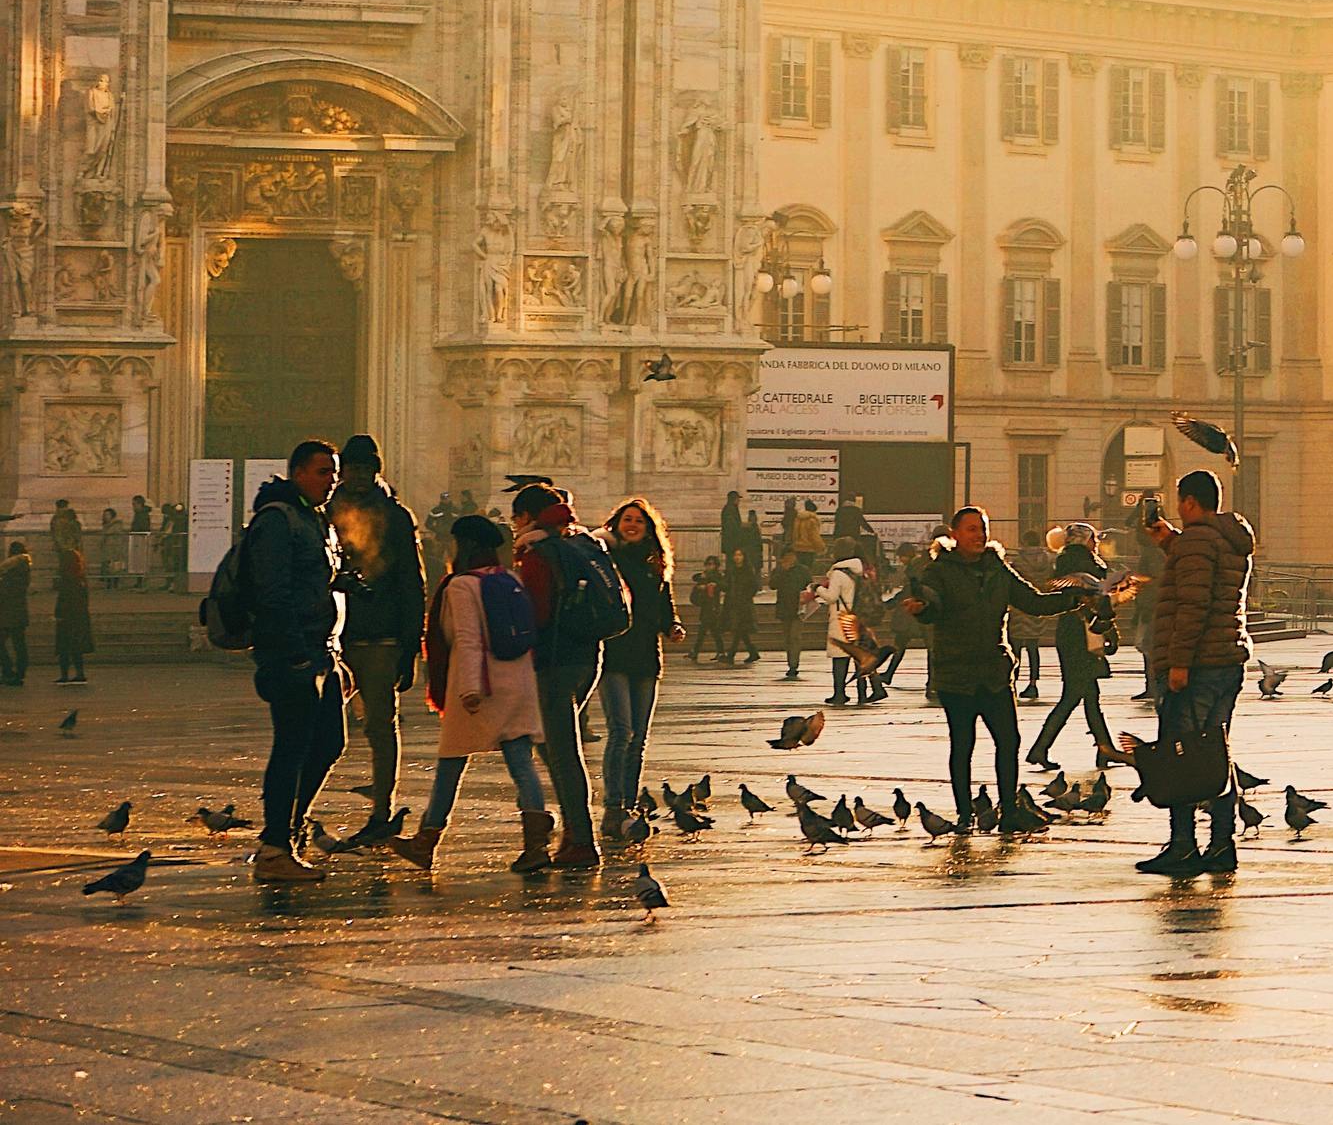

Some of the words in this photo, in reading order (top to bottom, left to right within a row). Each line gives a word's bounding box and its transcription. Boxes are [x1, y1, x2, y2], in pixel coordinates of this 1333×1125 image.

[760, 360, 786, 369] ANDA
[787, 360, 831, 370] FABBRICA
[832, 361, 849, 370] DEL
[851, 361, 890, 371] DUOMO
[892, 362, 902, 371] DI
[904, 362, 941, 371] MILANO
[762, 393, 834, 404] CATTEDRALE
[859, 394, 927, 405] BIGLIETTERIE
[844, 405, 883, 416] TICKET
